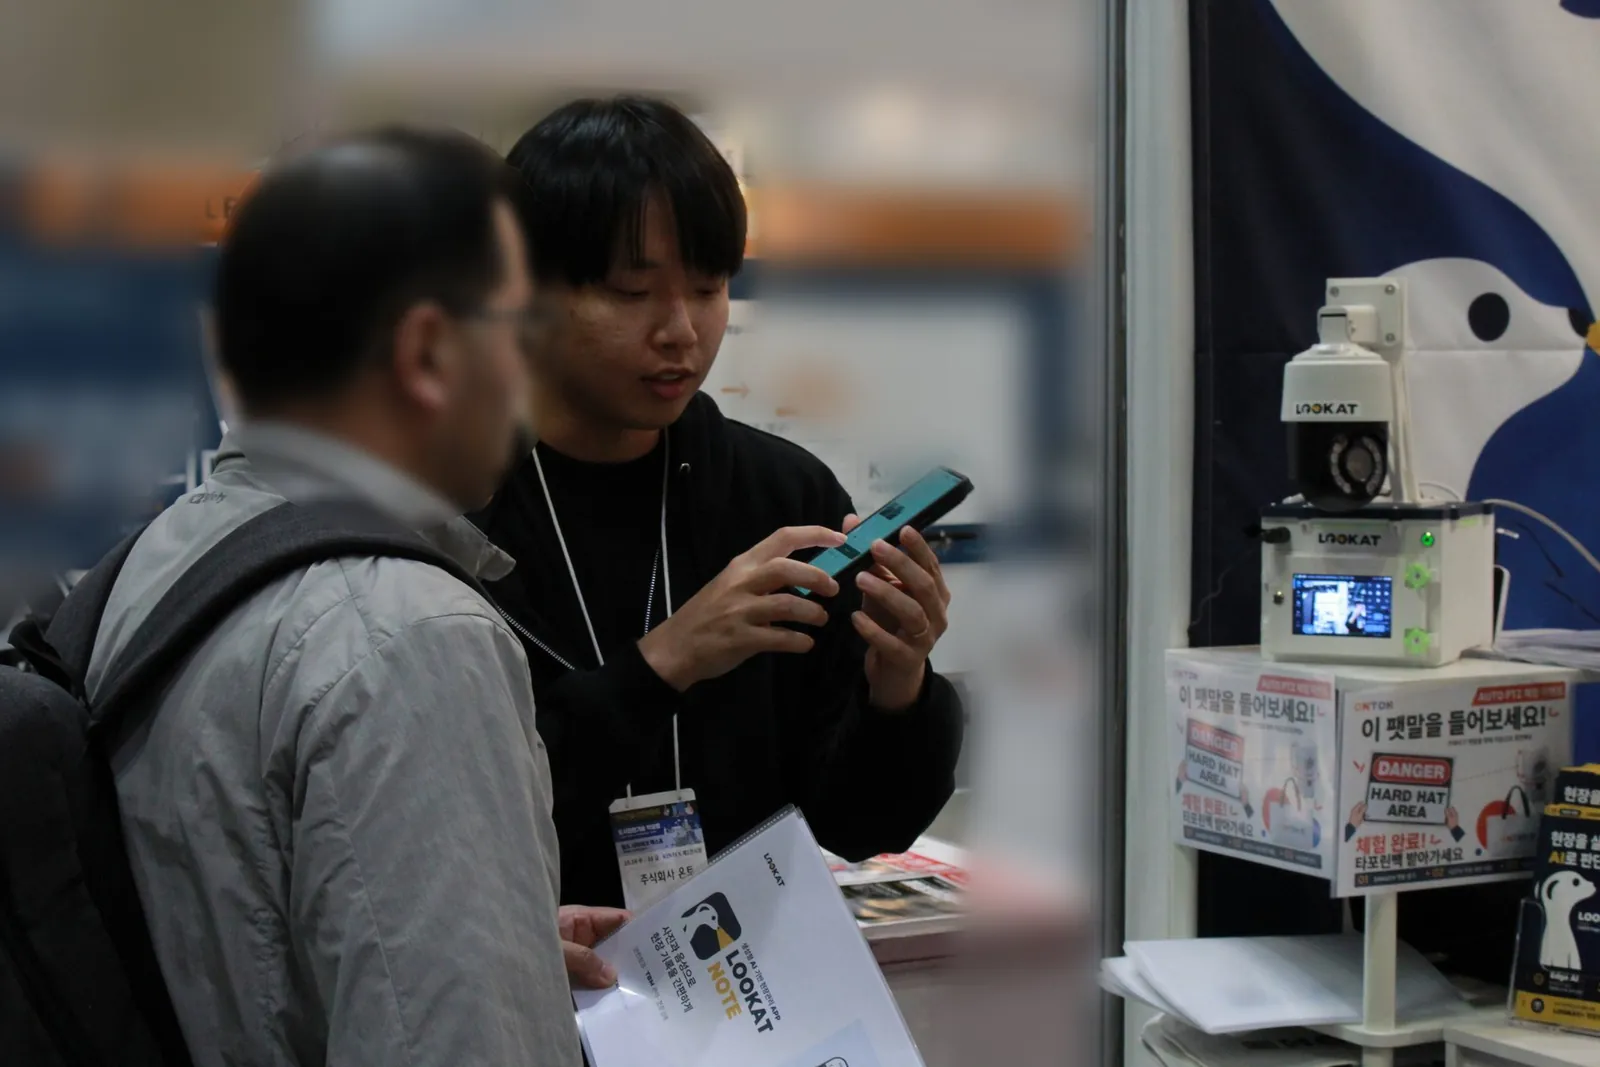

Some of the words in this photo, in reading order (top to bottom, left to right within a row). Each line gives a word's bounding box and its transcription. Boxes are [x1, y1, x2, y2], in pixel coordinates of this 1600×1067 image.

[1296, 403, 1359, 415] LOOKAT
[1318, 532, 1382, 546] LOOKAT
[1179, 685, 1191, 709] 이
[1240, 692, 1315, 723] 들어보세요!
[1362, 717, 1380, 742] 이
[1386, 712, 1443, 741] 팻말을
[1448, 706, 1546, 735] 들어보세요!
[1378, 760, 1445, 779] DANGER
[1371, 788, 1413, 803] HARD
[1417, 791, 1447, 804] HAT
[1387, 804, 1427, 819] AREA
[1356, 835, 1386, 855] 체험
[1391, 832, 1426, 852] 완료!
[641, 868, 675, 886] 주식회사
[763, 852, 785, 886] LOOKAT
[662, 926, 680, 952] 사진과
[674, 952, 696, 988] 음성으로
[650, 932, 665, 952] 현장
[672, 978, 694, 1013] 간편하게
[707, 961, 742, 1020] NOTE
[725, 949, 774, 1033] LOOKAT
[771, 1006, 781, 1021] APP
